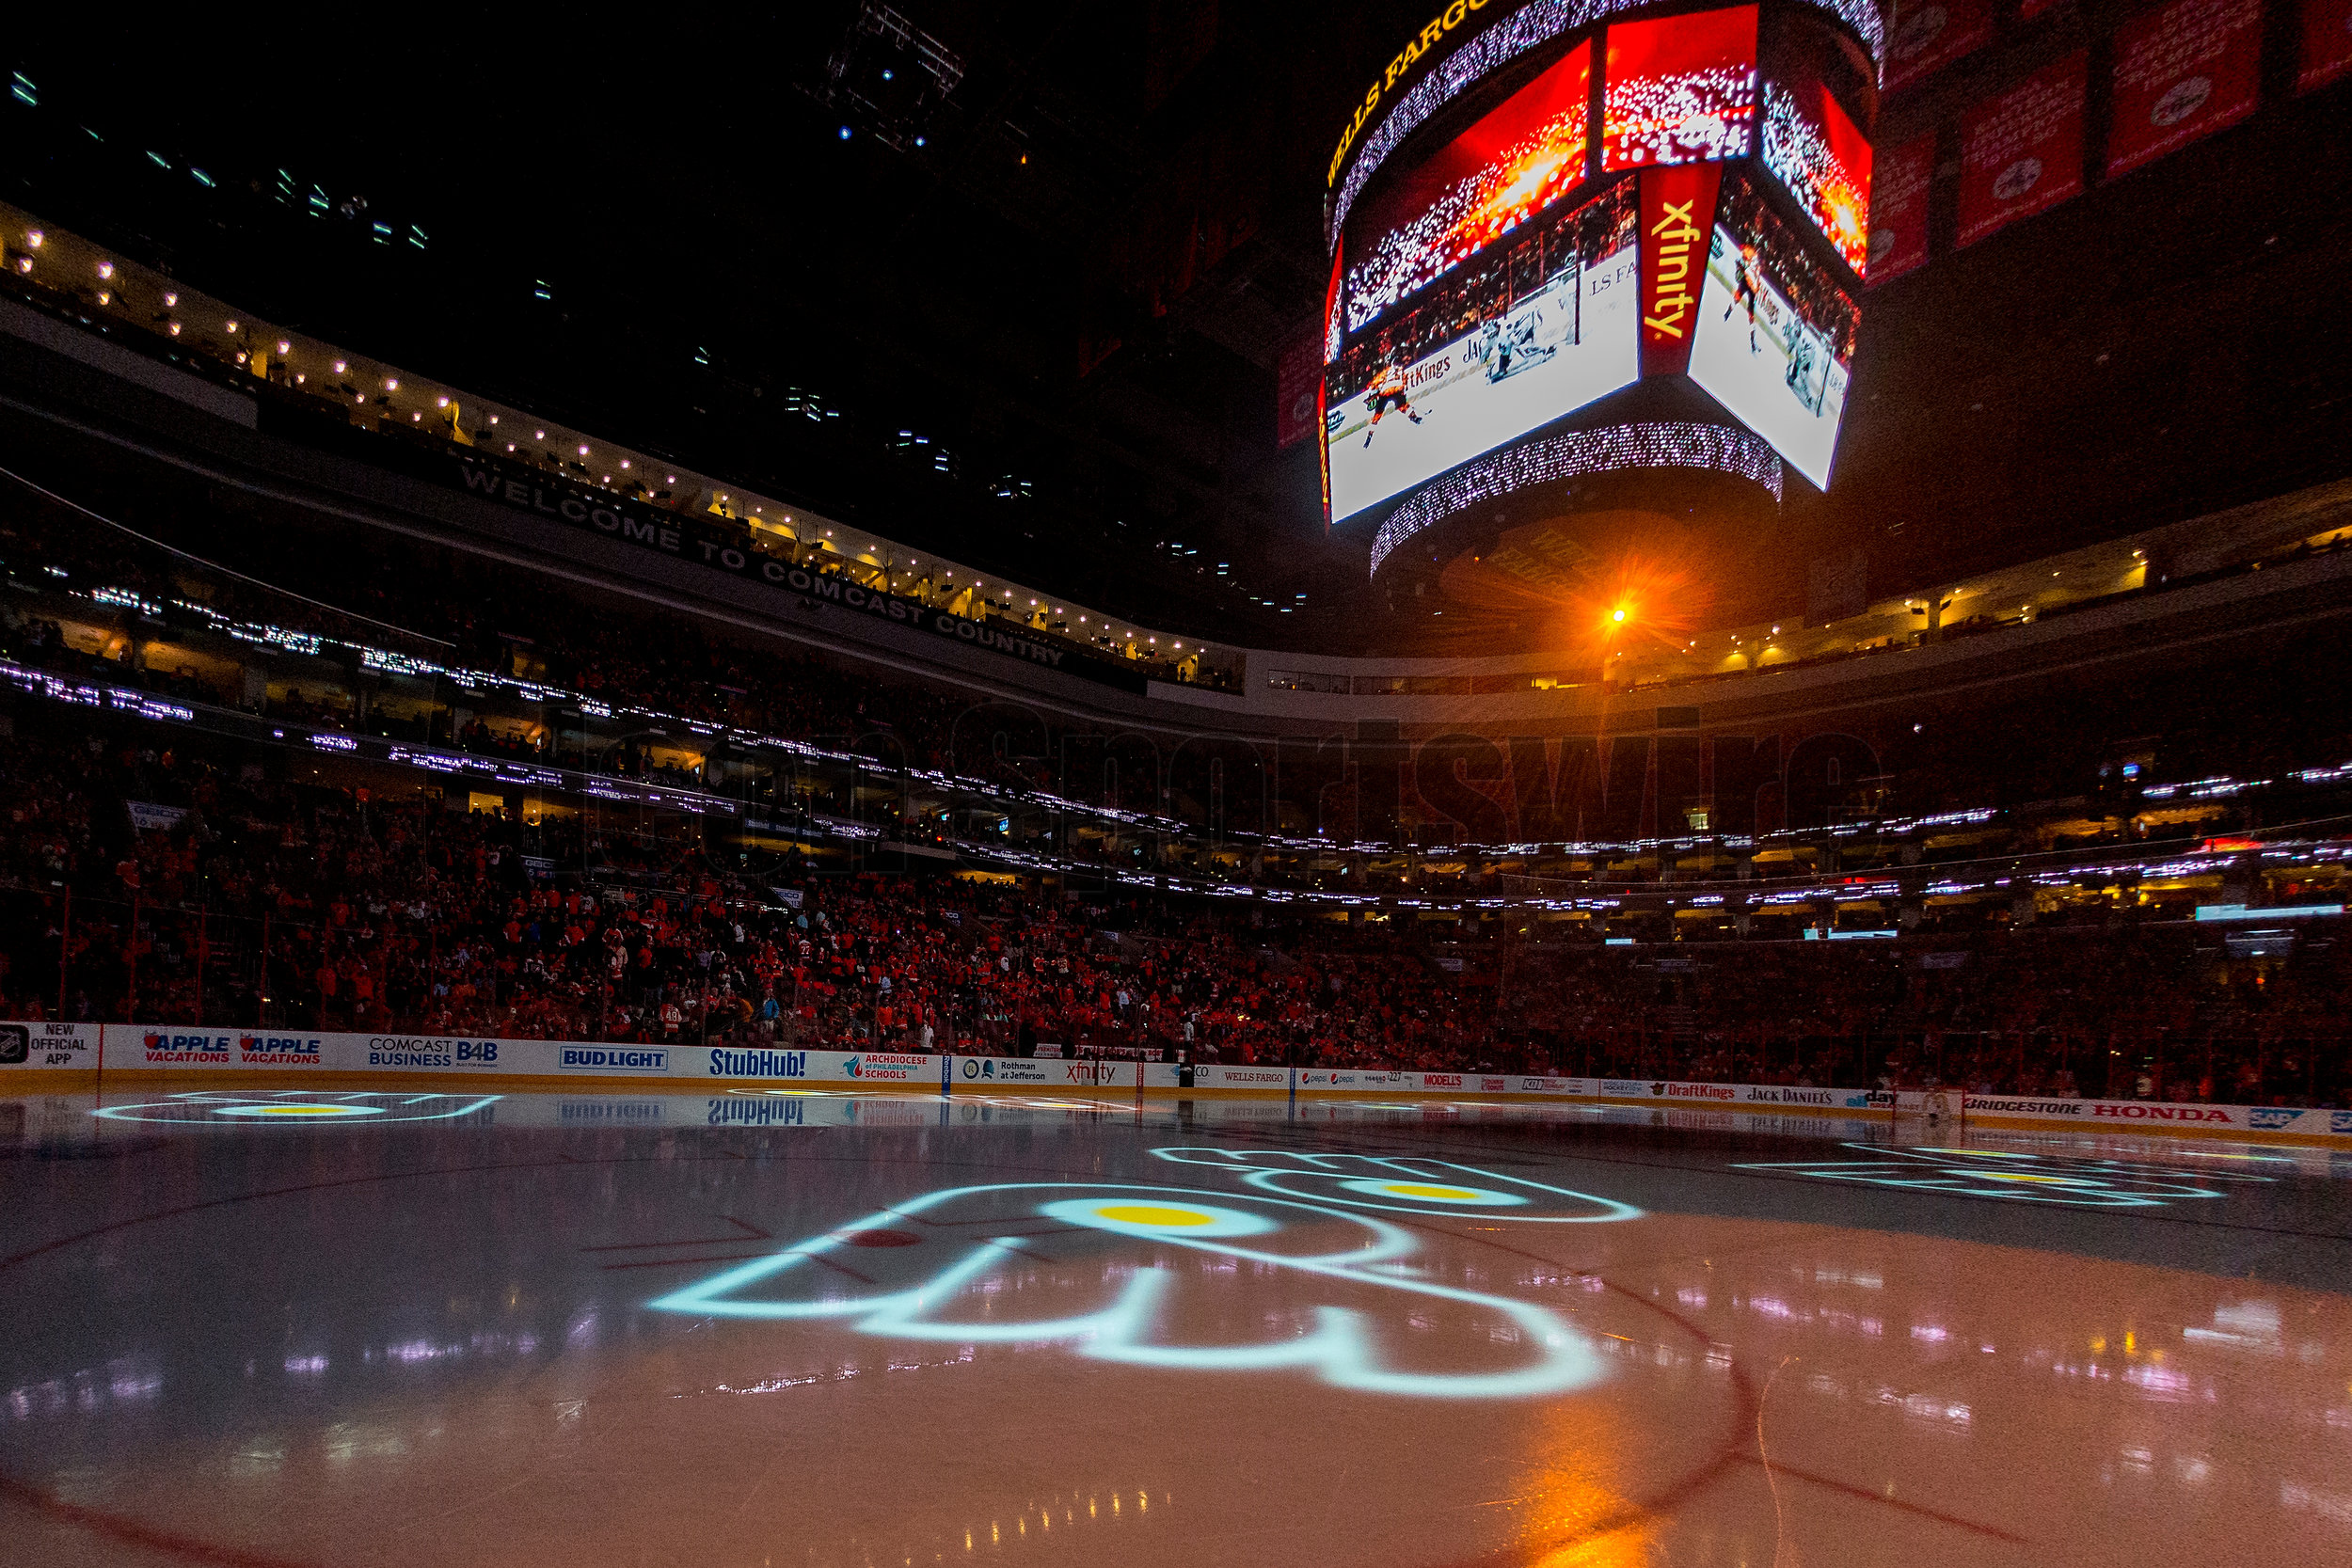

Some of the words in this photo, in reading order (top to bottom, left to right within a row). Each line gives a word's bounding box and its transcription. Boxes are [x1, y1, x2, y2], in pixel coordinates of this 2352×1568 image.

[1327, 80, 1380, 188] WELLS
[462, 468, 681, 552] WELCOME
[697, 542, 745, 570] TO
[762, 562, 927, 627] COMCAST
[935, 622, 1064, 667] COUNTRY
[45, 1023, 74, 1036] NEW
[31, 1037, 87, 1051] OFFICIAL
[155, 1036, 230, 1053] APPLE
[251, 1037, 322, 1054] APPLE
[369, 1037, 452, 1053] COMCAST
[456, 1040, 499, 1062] B4B
[45, 1053, 72, 1065] APP
[146, 1051, 230, 1064] VACATIONS
[240, 1052, 321, 1065] VACATIONS
[369, 1053, 452, 1067] BUSINESS
[564, 1050, 608, 1066] BUD
[609, 1051, 665, 1068] LIGHT
[708, 1048, 806, 1078] StubHub!
[866, 1053, 928, 1066] ARCHDIOCESE
[1000, 1061, 1036, 1070] Rothman
[865, 1069, 907, 1079] SCHOOLS
[1011, 1071, 1046, 1081] Jefferson
[1225, 1071, 1254, 1082] WELLS
[1256, 1072, 1283, 1083] FARGO
[1668, 1084, 1736, 1100] DraftKings
[1747, 1087, 1780, 1102] JACK
[1783, 1088, 1833, 1105] DANIEL'S
[1866, 1088, 1899, 1105] day
[1964, 1098, 2083, 1115] BRIDGESTONE
[2093, 1104, 2234, 1123] HONDA
[2249, 1111, 2291, 1127] SAP
